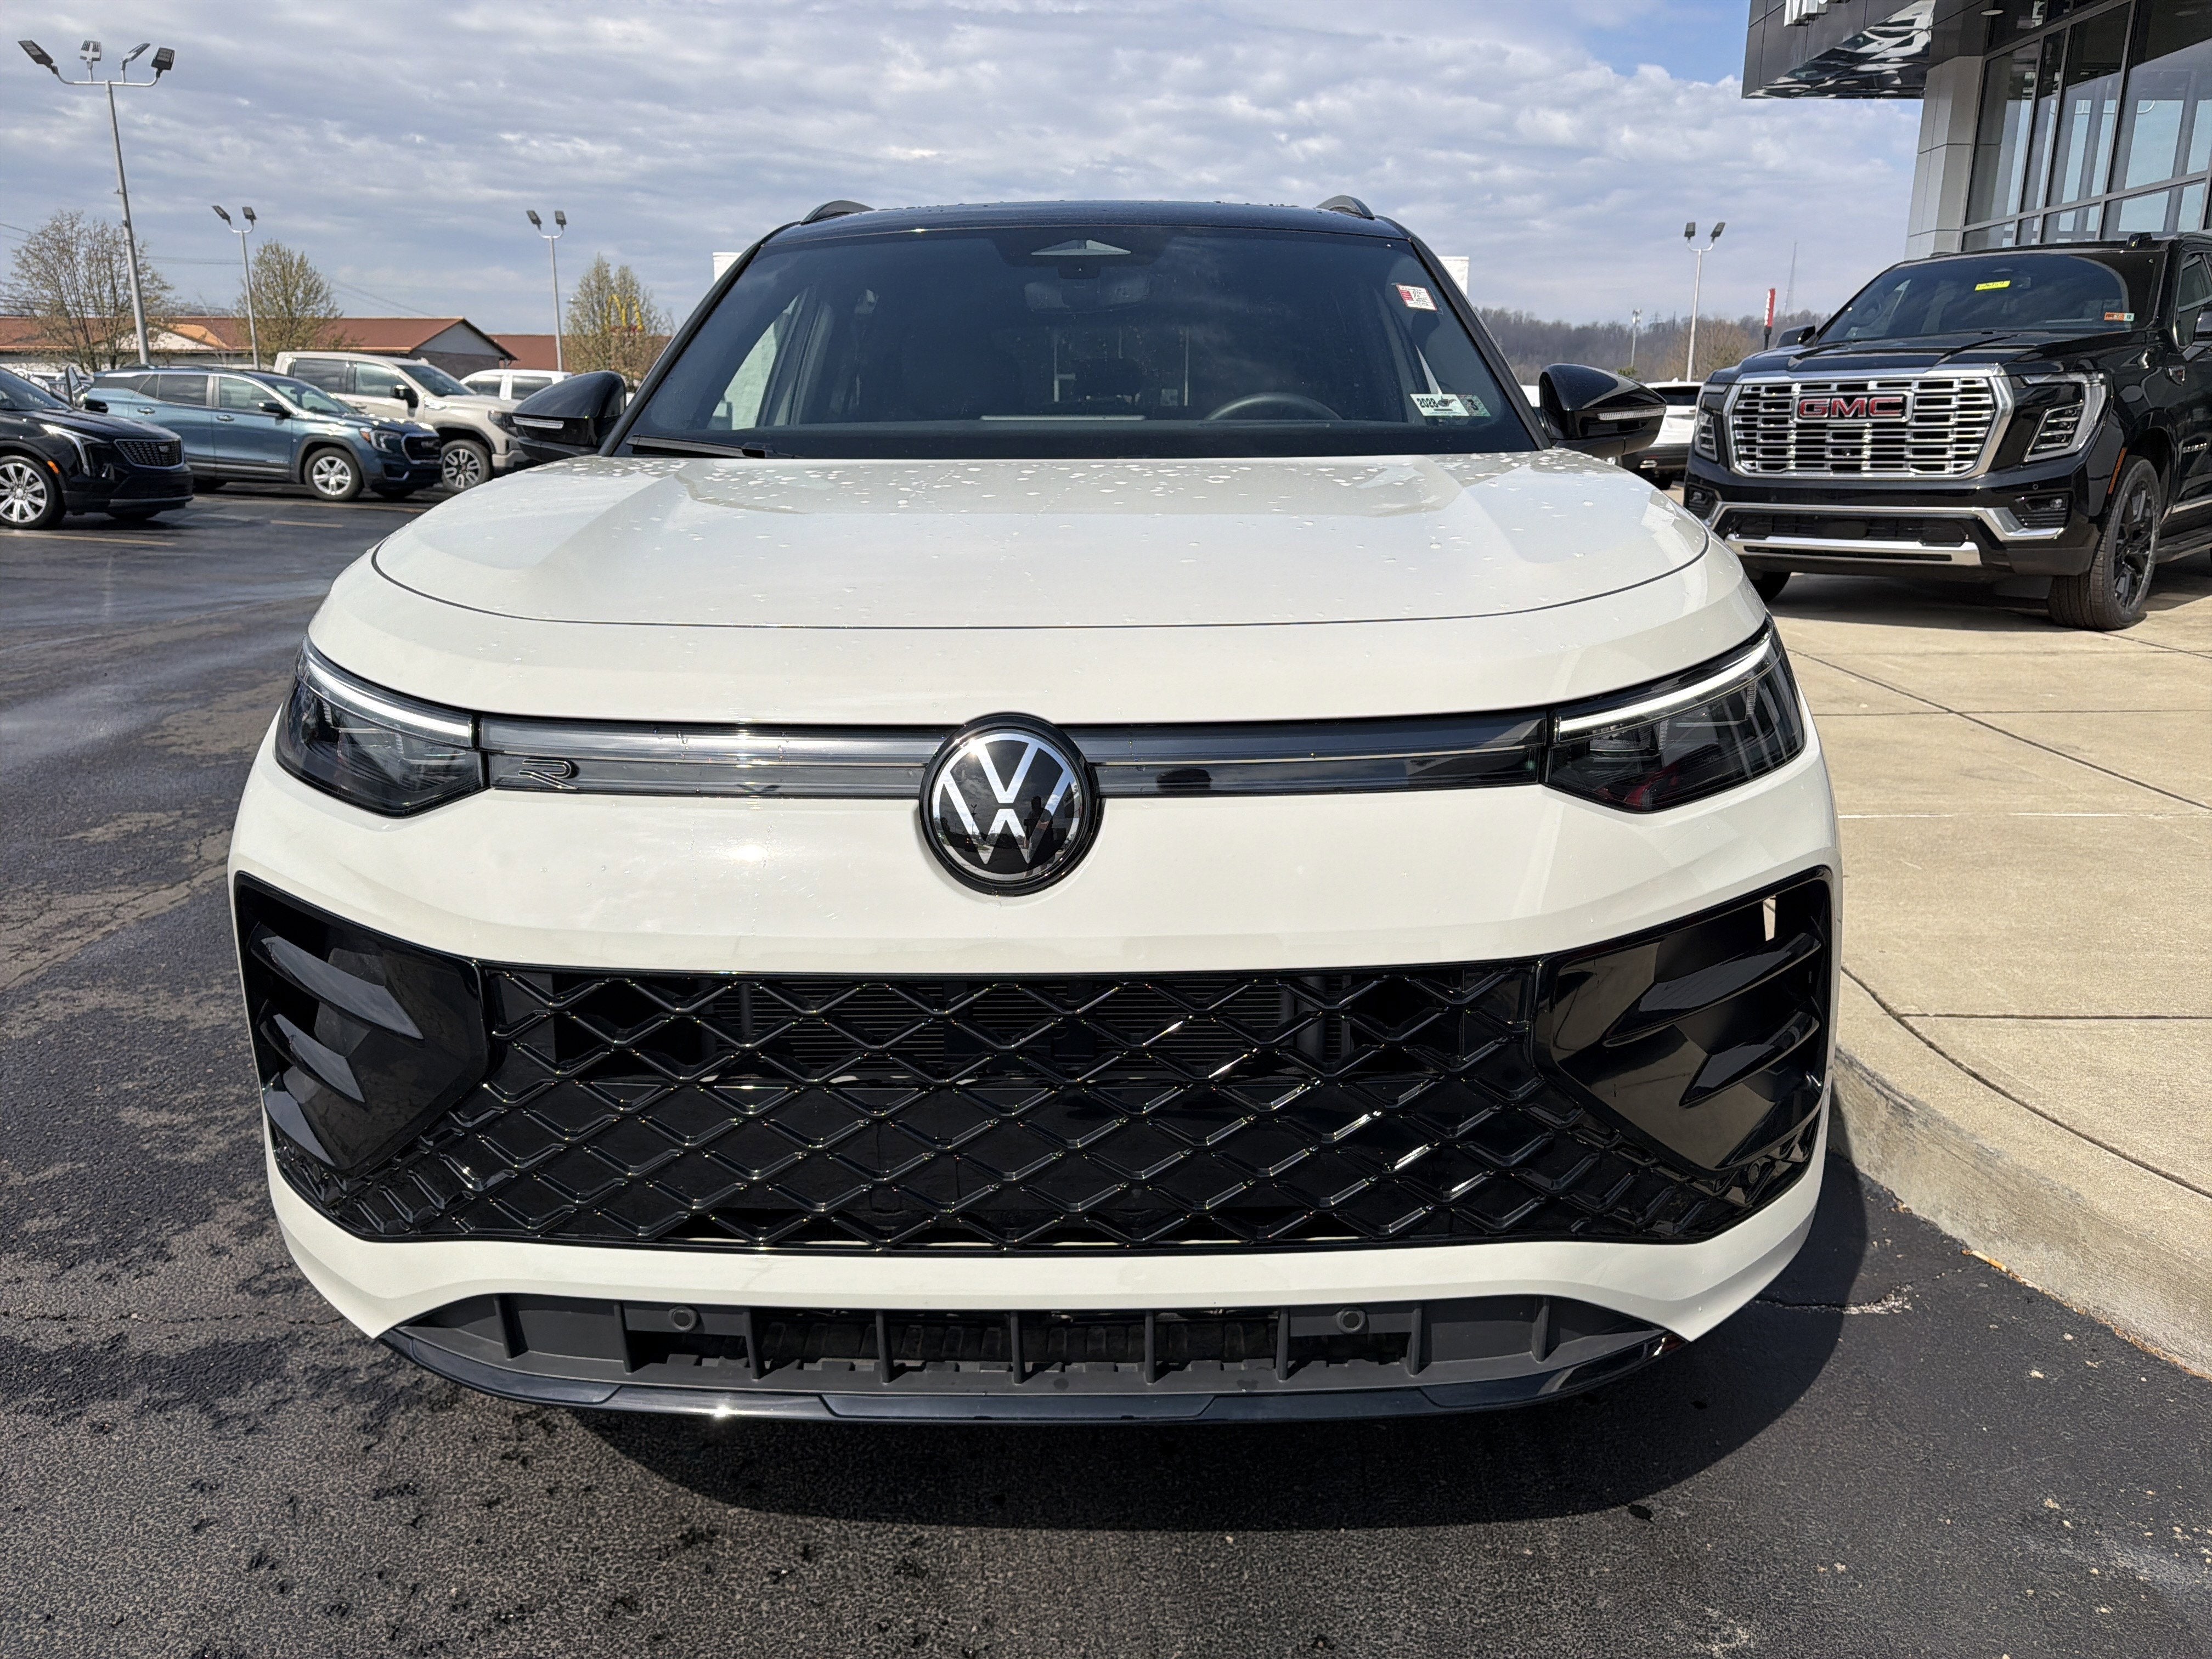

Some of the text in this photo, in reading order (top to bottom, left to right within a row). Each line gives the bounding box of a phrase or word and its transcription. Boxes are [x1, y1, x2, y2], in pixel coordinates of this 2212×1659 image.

[1416, 398, 1439, 408] 2028
[1466, 399, 1479, 411] 3
[1799, 397, 1904, 418] GMC
[517, 759, 579, 789] R
[935, 735, 1076, 865] VW
